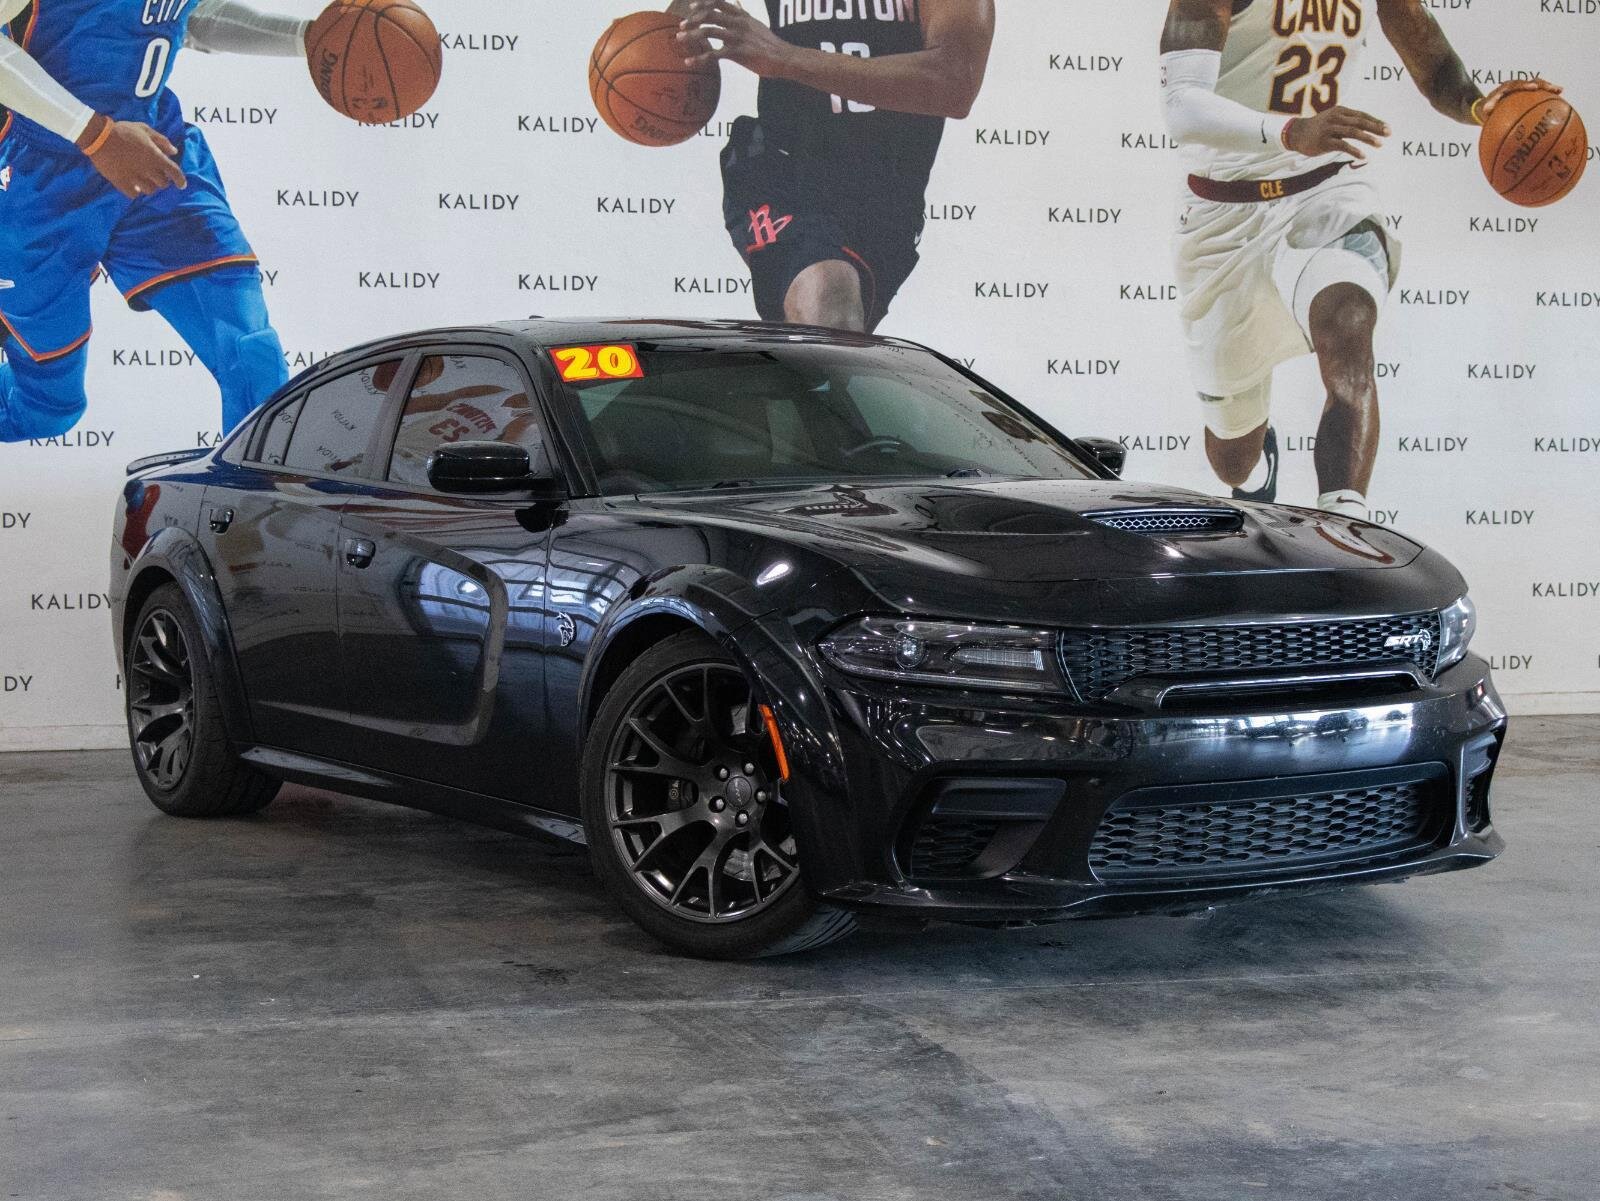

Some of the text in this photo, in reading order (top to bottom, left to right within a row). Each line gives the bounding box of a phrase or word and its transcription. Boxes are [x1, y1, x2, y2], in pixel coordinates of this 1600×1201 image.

[1272, 0, 1361, 37] CAVS
[439, 33, 518, 51] KALIDY
[135, 38, 170, 97] 0
[1049, 54, 1123, 72] KALIDY
[1269, 43, 1346, 115] 23
[194, 107, 278, 125] KALIDY
[518, 115, 598, 133] KALIDY
[976, 128, 1050, 145] KALIDY
[1121, 133, 1178, 149] KALI
[1402, 141, 1472, 157] KALIDY
[1260, 180, 1284, 198] CLE
[277, 189, 360, 207] KALIDY
[439, 193, 520, 211] KALIDY
[597, 197, 676, 214] KALIDY
[924, 204, 977, 221] LIDY
[1049, 207, 1122, 224] KALIDY
[1469, 216, 1539, 233] KALIDY
[359, 271, 440, 289] KALIDY
[518, 274, 598, 292] KALIDY
[674, 277, 752, 294] KALIDY
[974, 281, 1049, 298] KALIDY
[1119, 284, 1177, 300] KALID
[1400, 289, 1470, 305] KALIDY
[113, 349, 196, 366] KALIDY
[555, 346, 636, 379] 20
[1047, 359, 1121, 375] KALIDY
[1467, 364, 1537, 379] KALIDY
[1119, 435, 1191, 451] KALIDY
[1398, 437, 1468, 452] KALIDY
[1534, 437, 1600, 453] KALIDY
[1465, 510, 1535, 525] KALIDY
[1532, 582, 1600, 598] KALIDY
[31, 593, 112, 610] KALIDY
[1384, 634, 1422, 648] SRT
[1490, 655, 1533, 670] LIDY
